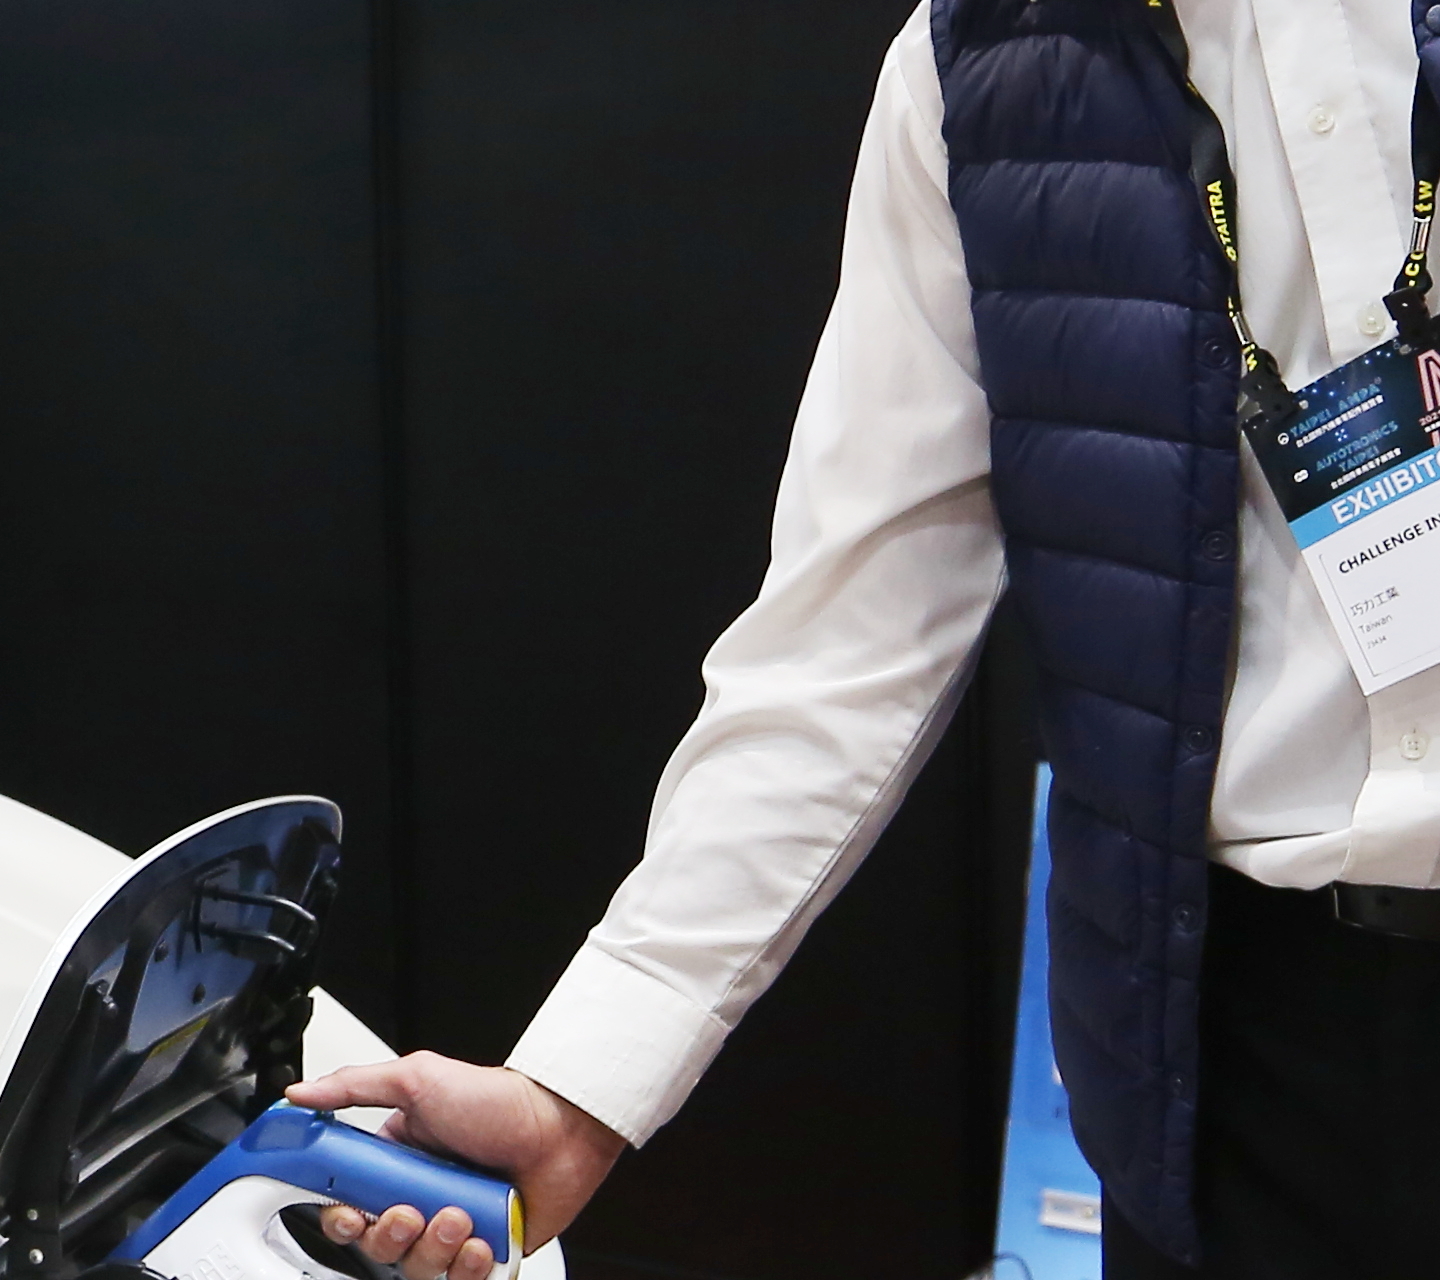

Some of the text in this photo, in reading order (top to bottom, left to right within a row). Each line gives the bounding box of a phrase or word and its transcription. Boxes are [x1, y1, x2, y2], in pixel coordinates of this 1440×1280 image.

[1290, 408, 1330, 437] TAIPEI
[1316, 420, 1399, 471] AUTOTRONICS
[1338, 447, 1378, 472] TAIPEI
[1339, 520, 1425, 574] CHALLENGE
[1358, 613, 1393, 634] Taiwan
